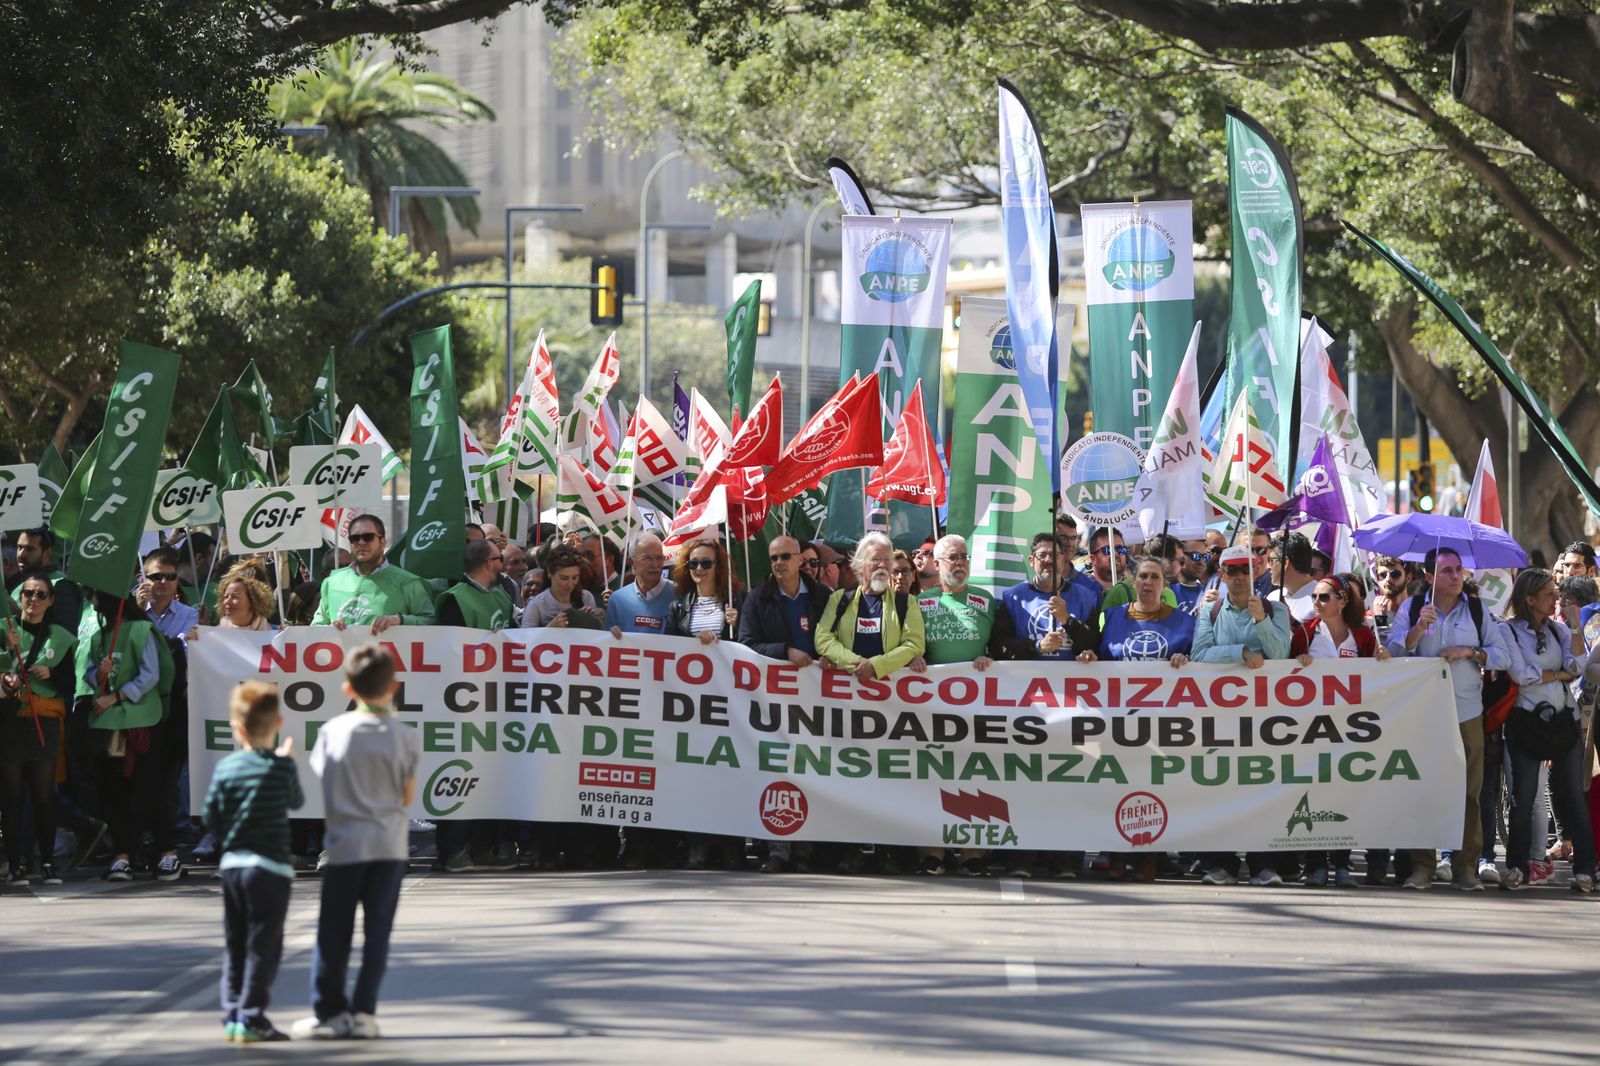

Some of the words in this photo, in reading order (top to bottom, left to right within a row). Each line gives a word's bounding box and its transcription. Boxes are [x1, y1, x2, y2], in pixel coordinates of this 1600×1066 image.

[1101, 222, 1128, 250] SINDICATO
[1129, 217, 1176, 247] INDEPENDIENTE
[859, 232, 888, 260] SINDICATO
[869, 273, 920, 292] ANPE
[1112, 263, 1164, 281] ANPE
[1062, 439, 1093, 471] SINDICATO
[1078, 482, 1135, 503] ANPE
[1083, 508, 1136, 525] ANDALUCÍA
[259, 641, 344, 673] NO
[462, 642, 714, 685] DECRETO
[733, 659, 799, 696] DE
[821, 667, 1362, 708] ESCOLARIZACIÓN
[443, 681, 641, 720] CIERRE
[662, 690, 730, 727] DE
[748, 700, 1048, 745] UNIDADES
[1071, 708, 1382, 748] PÚBLICAS
[582, 724, 655, 760] DE
[675, 731, 741, 768] LA
[758, 740, 1129, 785] ENSEÑANZA
[1151, 748, 1421, 786] PÚBLICA
[434, 776, 479, 797] CSIF
[579, 790, 654, 807] enseñanza
[766, 788, 801, 808] UGT
[1121, 802, 1158, 820] FRENTE
[942, 823, 1018, 847] USTEA
[1122, 817, 1163, 832] ESTUDIANTES
